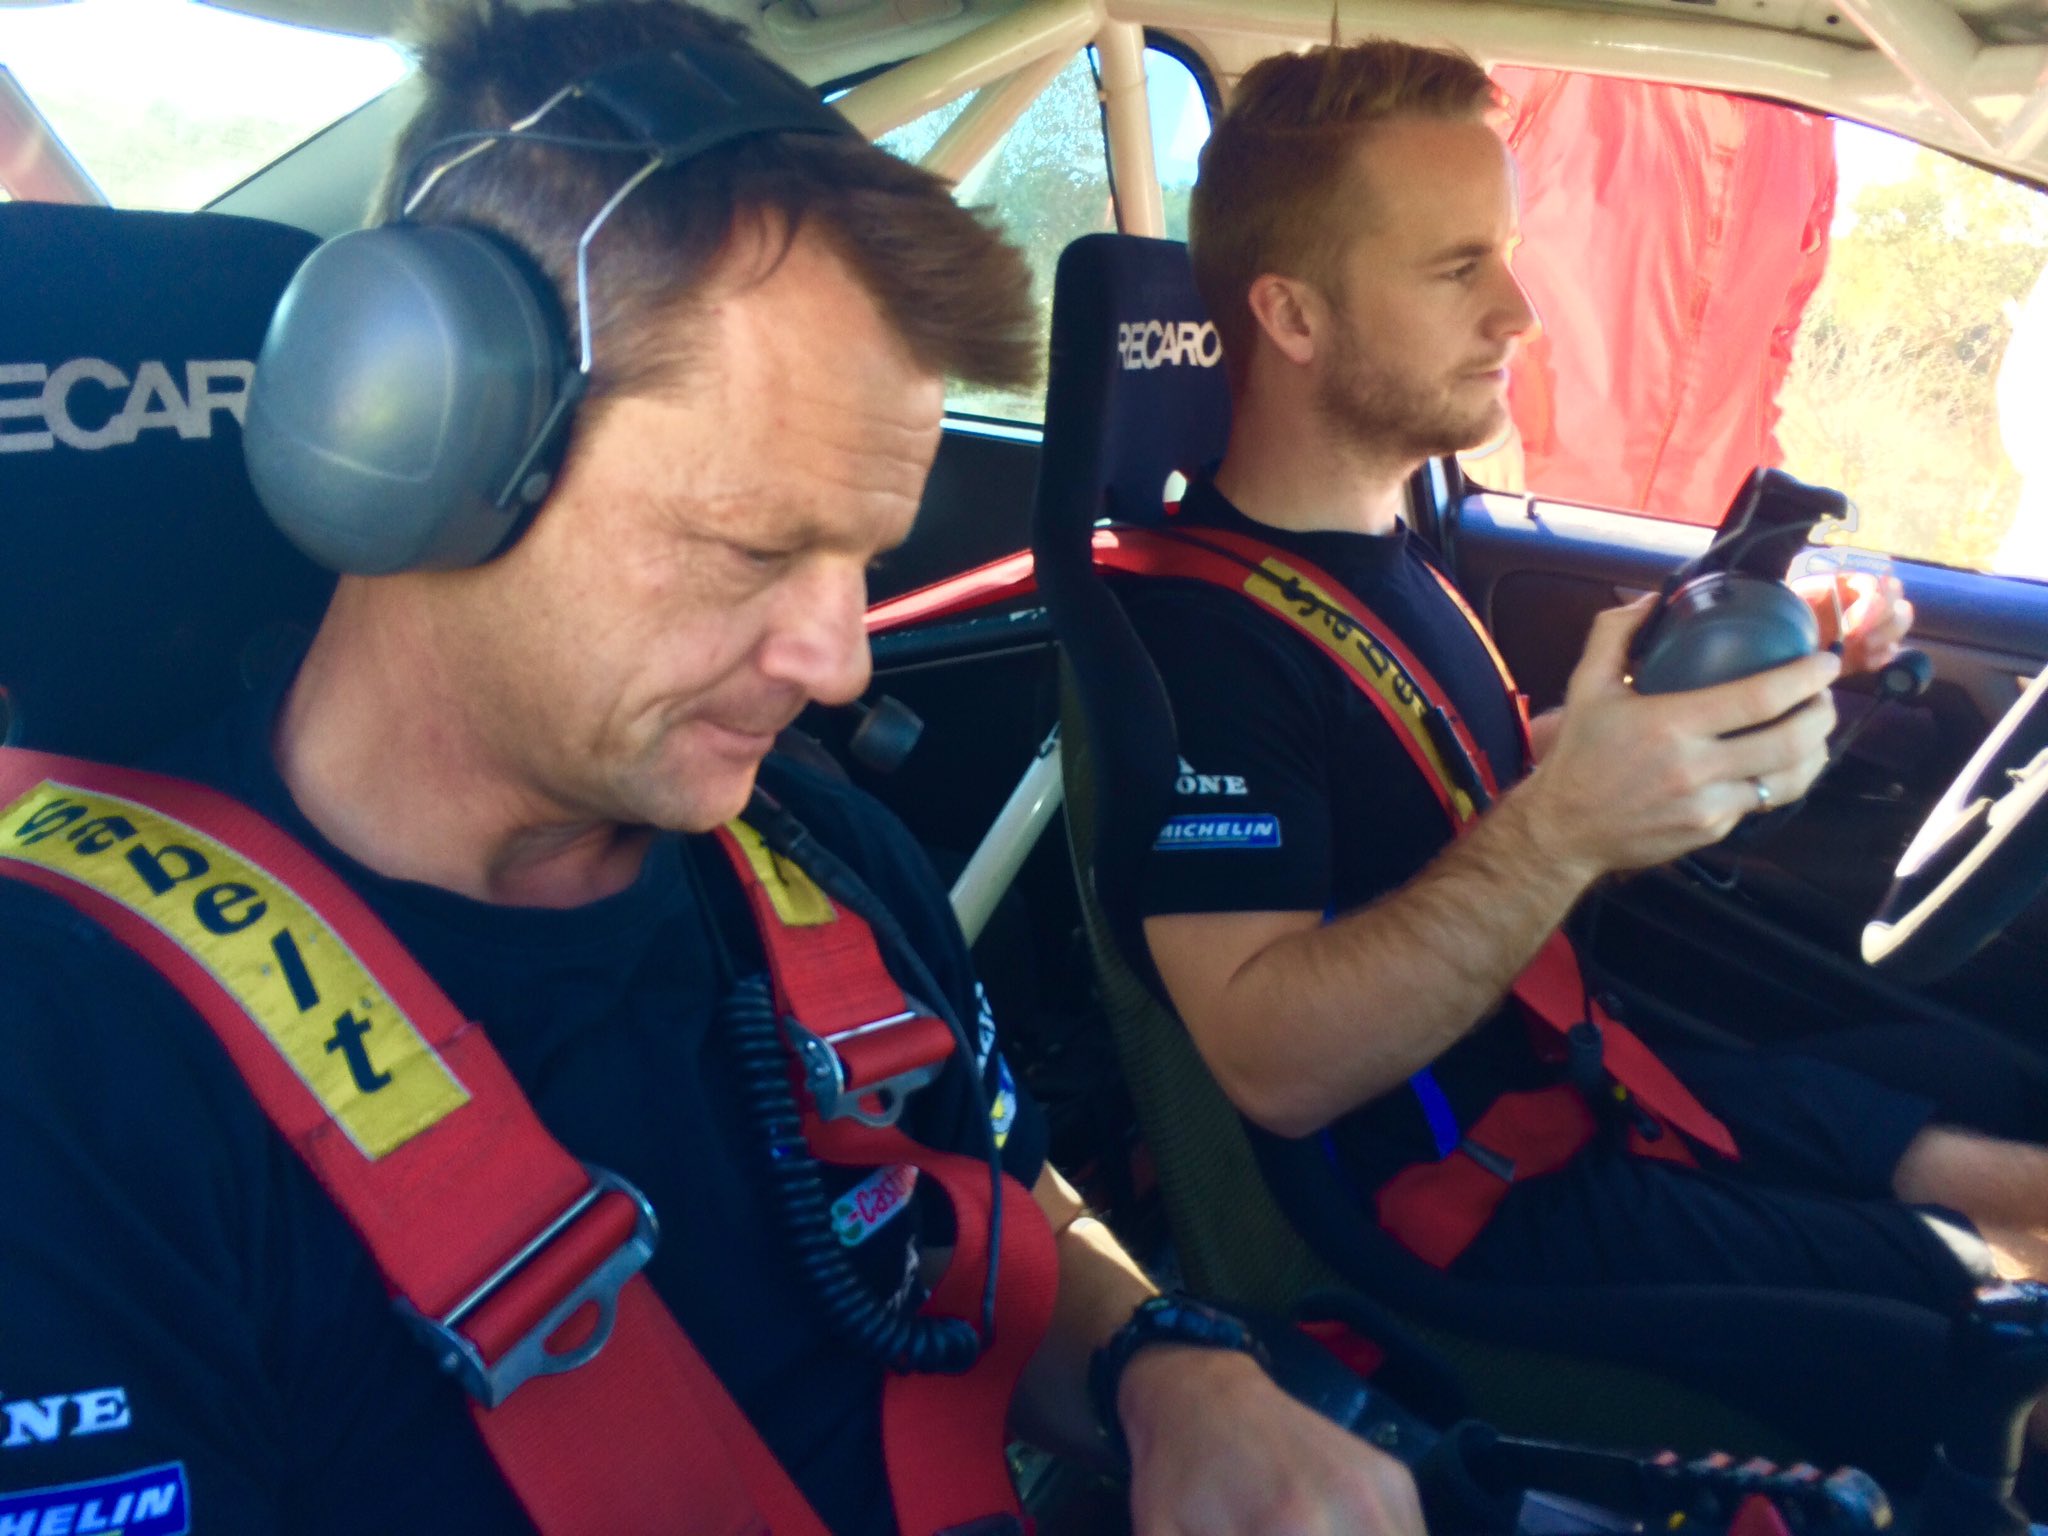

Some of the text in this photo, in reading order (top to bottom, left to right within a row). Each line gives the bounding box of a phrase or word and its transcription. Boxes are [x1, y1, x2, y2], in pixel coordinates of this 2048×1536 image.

[1118, 319, 1223, 370] RECARO
[0, 357, 256, 452] ECAR
[14, 799, 392, 1094] Sabelt
[0, 1386, 130, 1447] NE
[0, 1482, 177, 1536] HELIN
